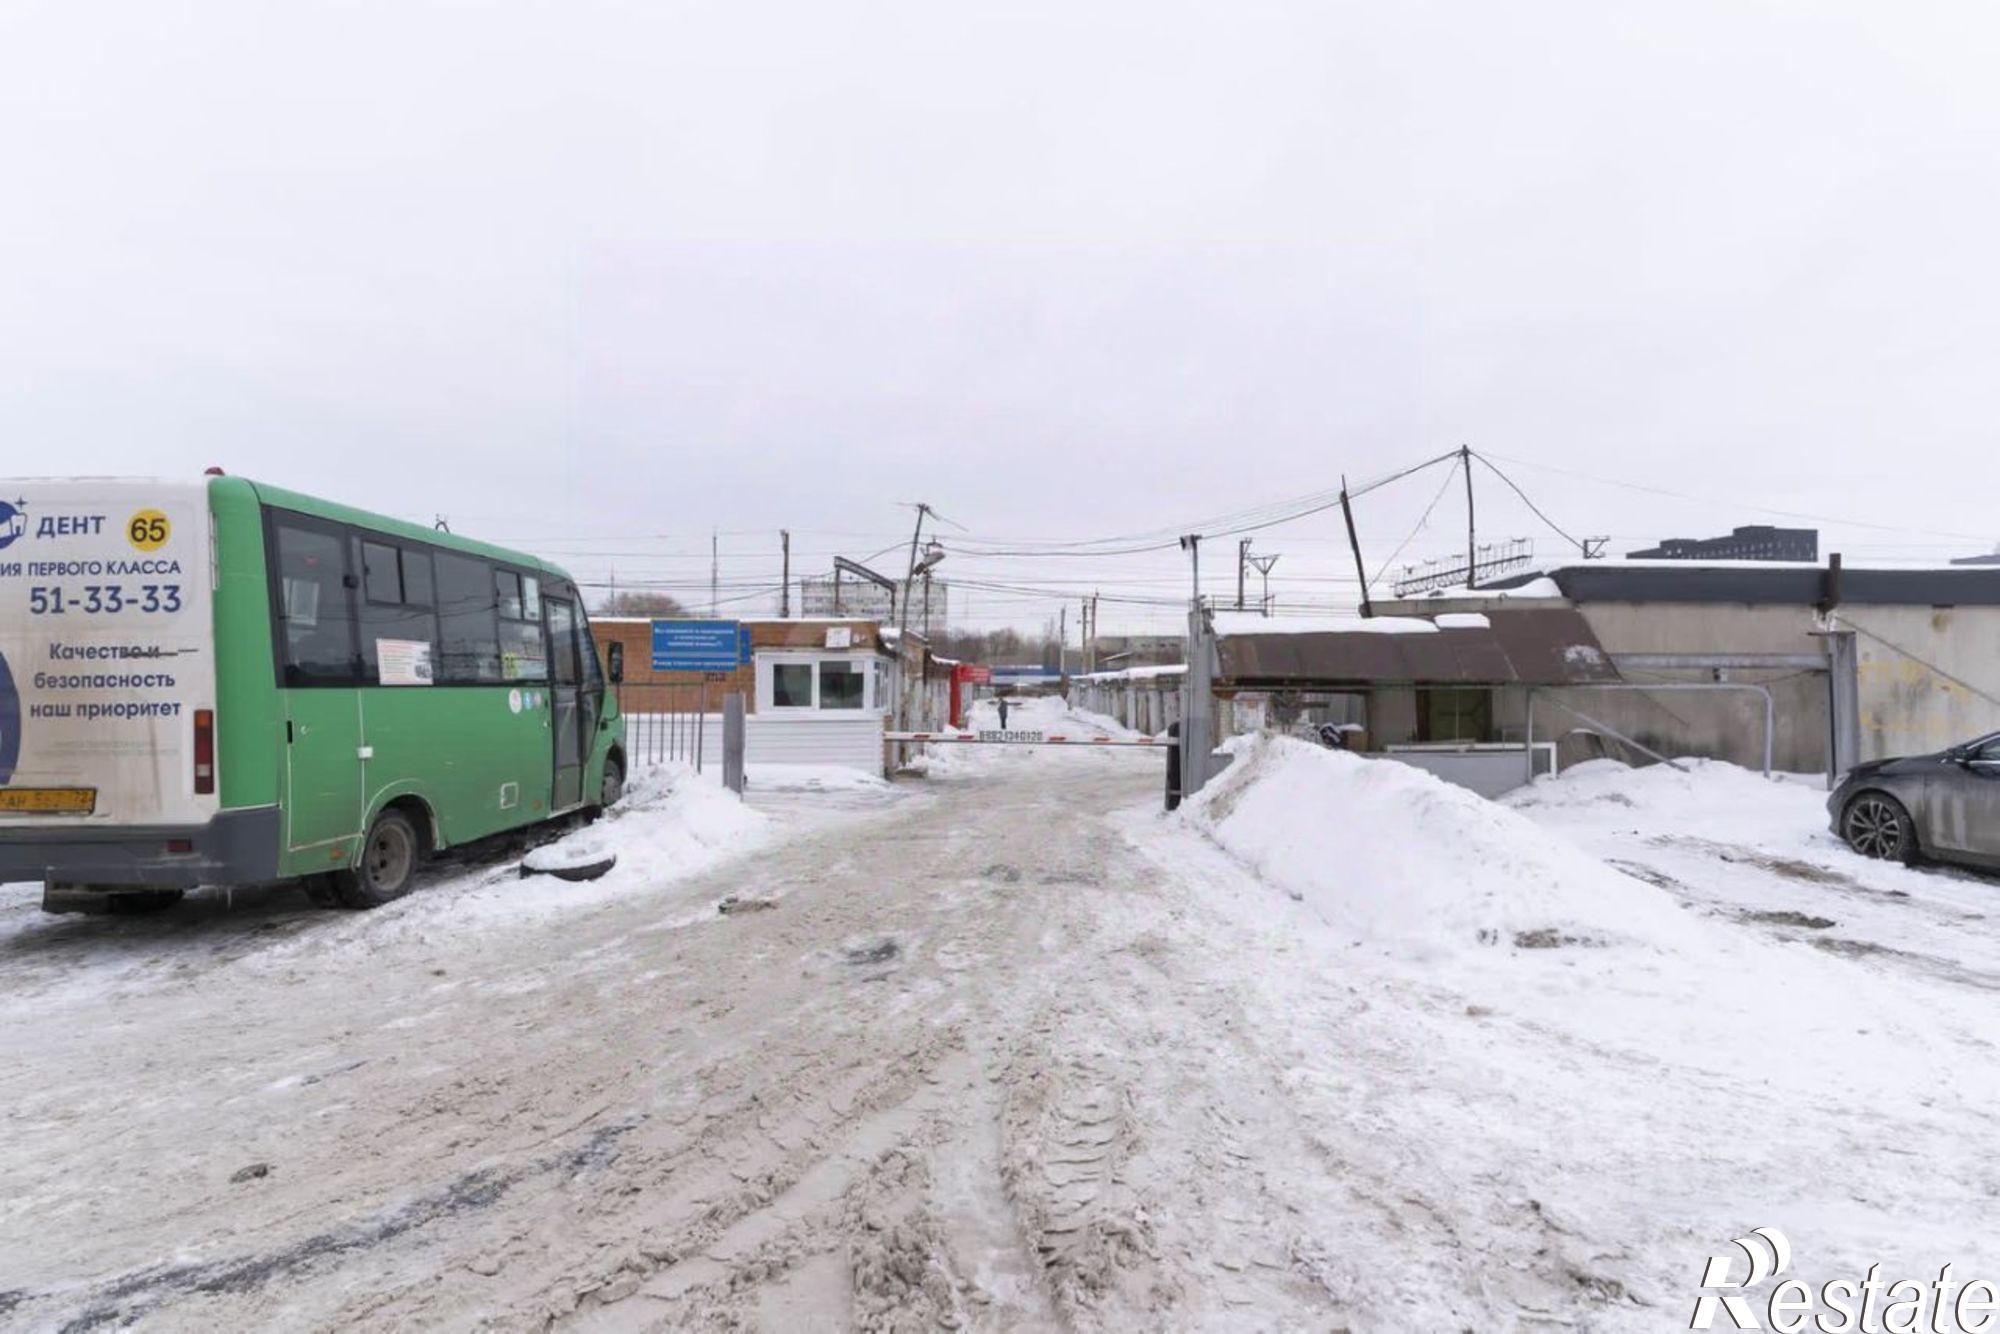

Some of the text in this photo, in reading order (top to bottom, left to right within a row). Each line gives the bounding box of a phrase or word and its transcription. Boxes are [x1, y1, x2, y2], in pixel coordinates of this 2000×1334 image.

[36, 515, 106, 539] ДЕНТ
[131, 518, 165, 542] 65
[28, 561, 102, 576] ПЕРВОГО
[106, 560, 181, 574] КЛАССА
[30, 585, 181, 614] 51-33-33
[50, 643, 160, 660] Качество и
[34, 672, 175, 689] безопасность
[30, 702, 181, 720] наш приоритет
